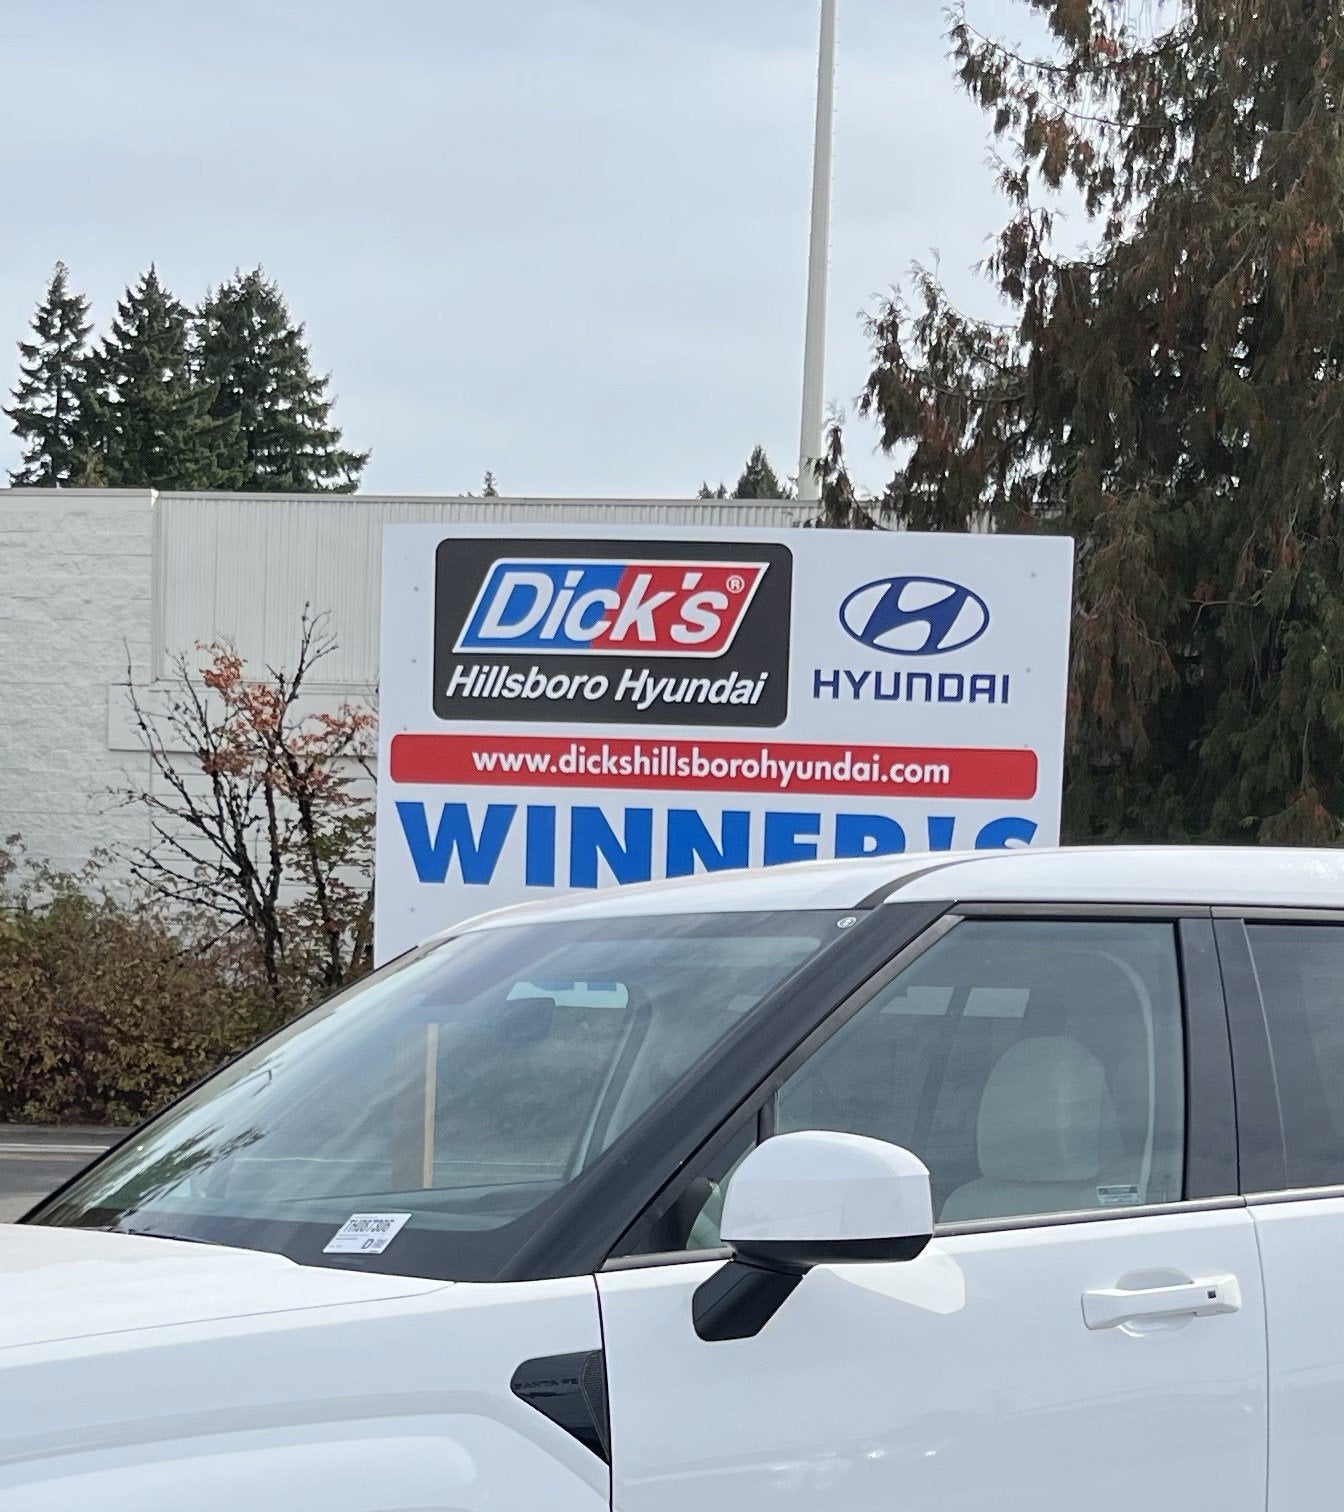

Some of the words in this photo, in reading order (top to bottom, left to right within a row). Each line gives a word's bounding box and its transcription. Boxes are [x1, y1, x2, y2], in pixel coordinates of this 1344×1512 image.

[477, 569, 729, 645] Dick's
[446, 664, 608, 699] Hillsboro
[615, 669, 769, 710] Hyundai
[813, 669, 1009, 704] HYUNDAI
[472, 746, 950, 787] www.dickshillsborohyundai.com
